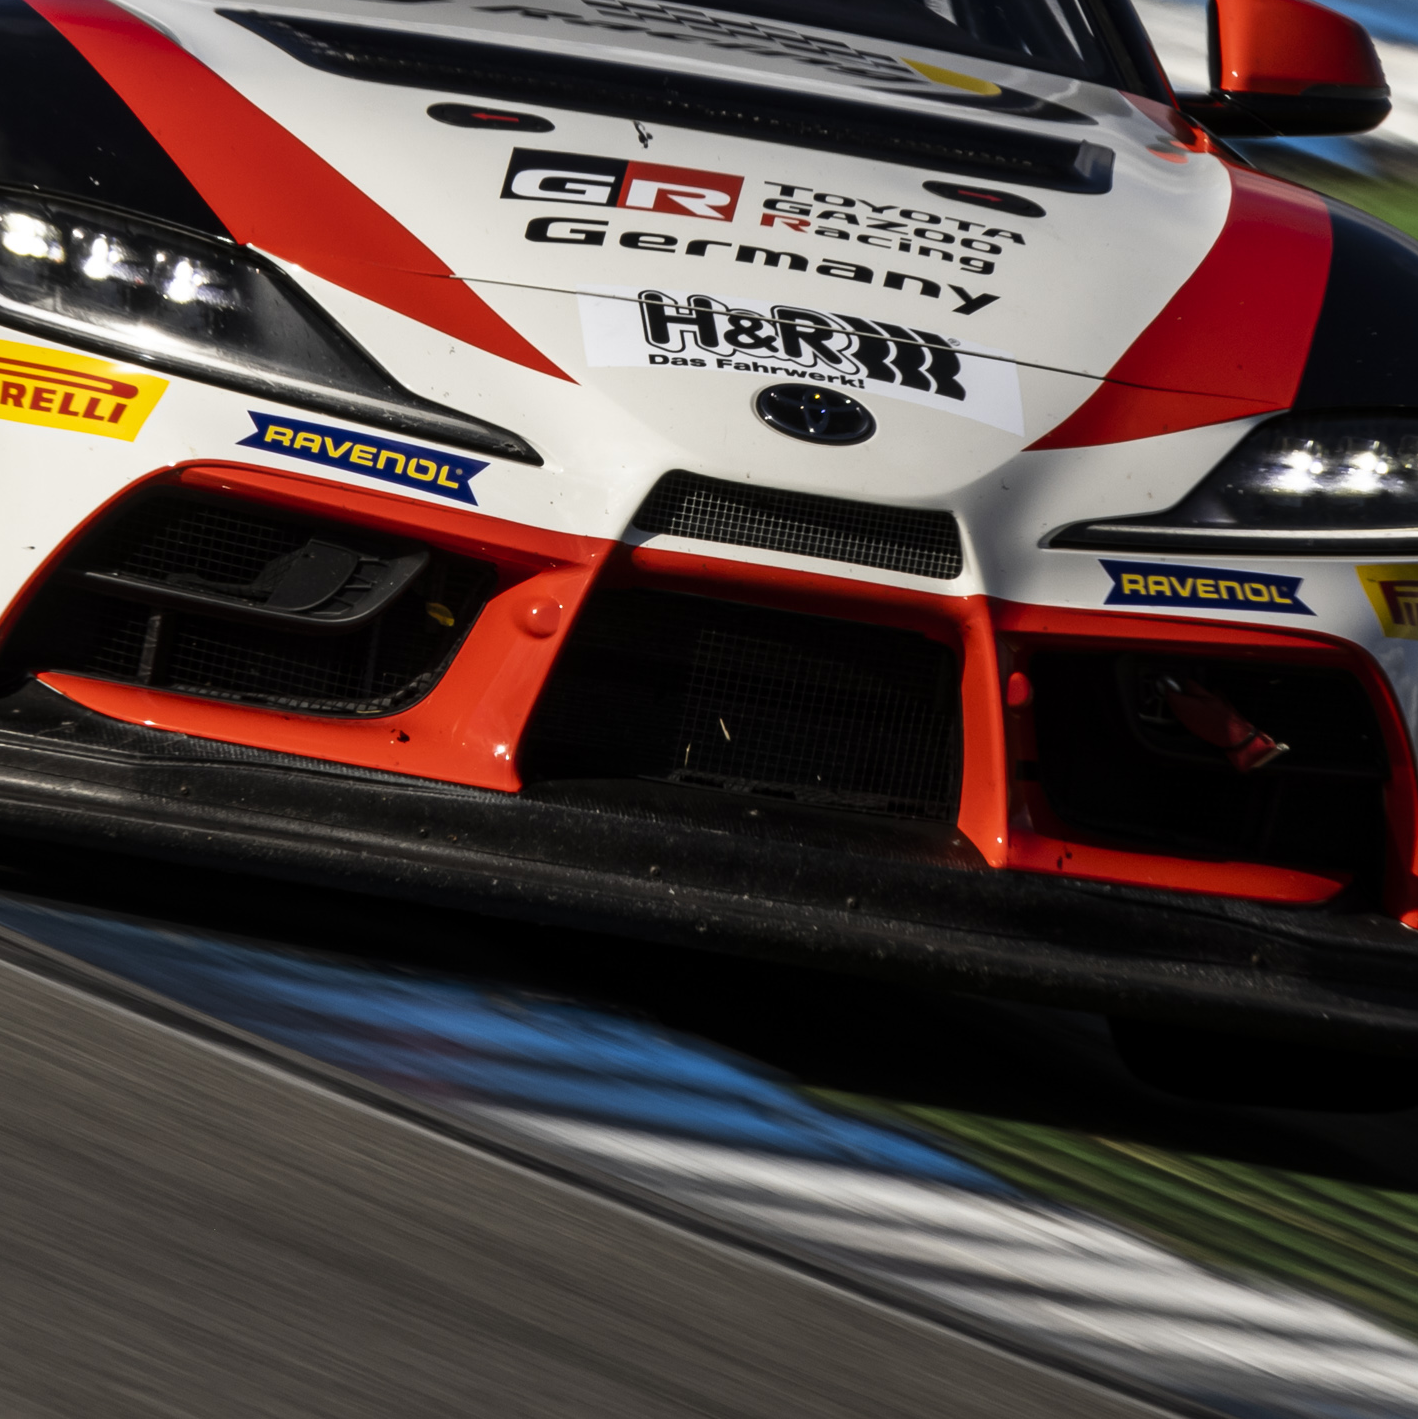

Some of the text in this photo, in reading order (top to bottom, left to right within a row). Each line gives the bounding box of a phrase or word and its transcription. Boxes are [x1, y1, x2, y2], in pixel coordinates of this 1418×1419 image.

[511, 167, 733, 221] GR
[763, 180, 1027, 246] TOYOTA
[759, 212, 996, 276] Racing
[762, 197, 1003, 256] GAZOO
[524, 216, 1001, 316] Germany
[648, 353, 866, 390] Das Fahrwerk!
[262, 424, 463, 490] RAVENOL
[1120, 573, 1294, 605] RAVENOL
